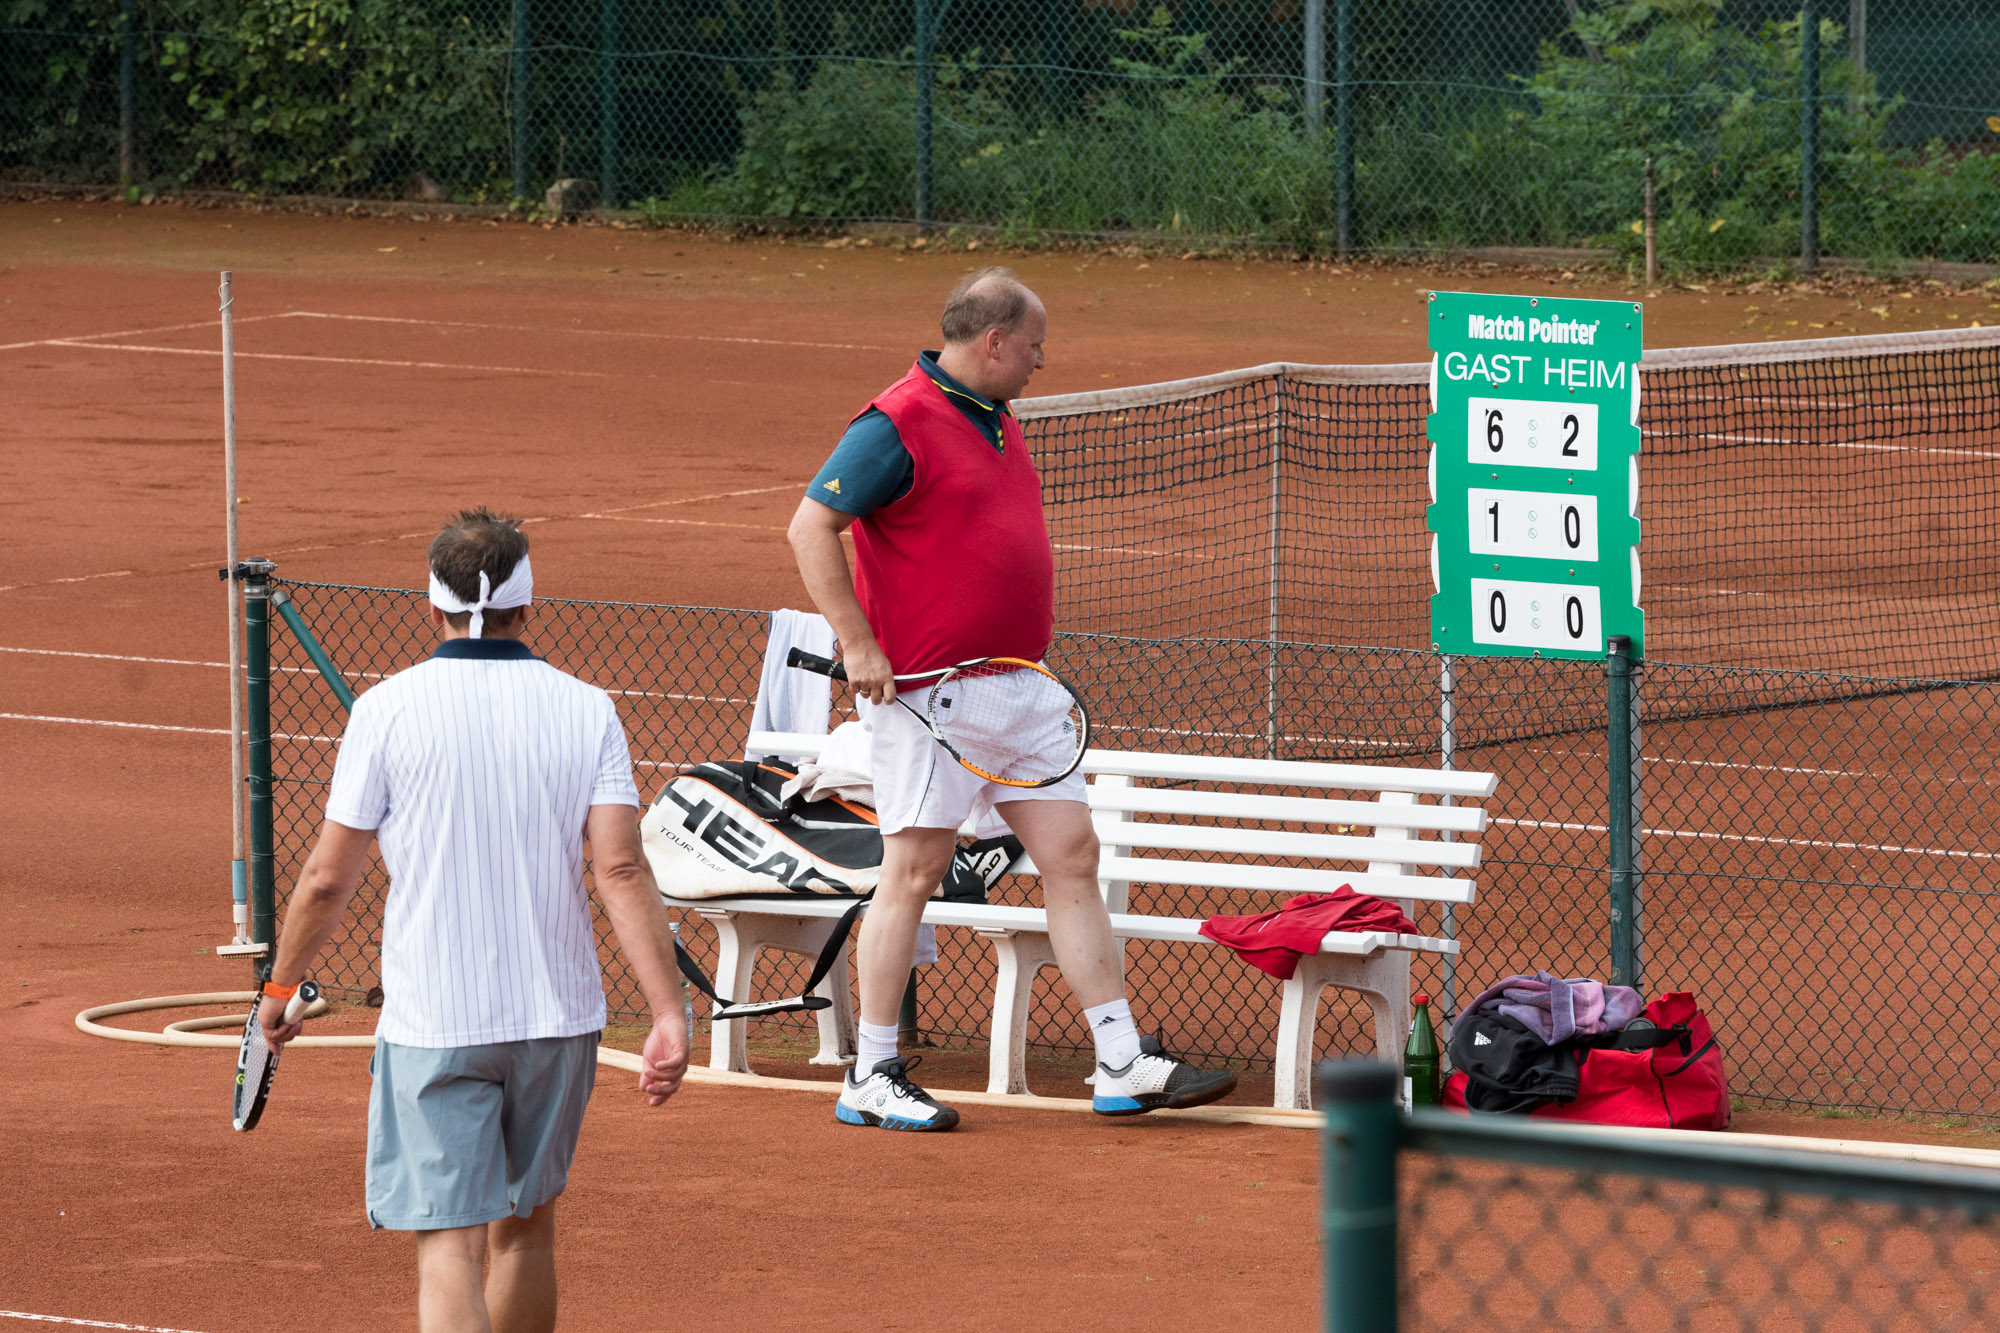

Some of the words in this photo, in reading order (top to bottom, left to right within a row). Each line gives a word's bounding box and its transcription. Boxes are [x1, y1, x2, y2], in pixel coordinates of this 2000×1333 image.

[1468, 314, 1525, 341] Match
[1443, 351, 1532, 383] GAST
[1544, 357, 1625, 389] HEIM
[1487, 409, 1504, 453] 6
[1562, 414, 1579, 457] 2
[1488, 501, 1499, 543] 1
[1564, 505, 1581, 549] 0
[1490, 590, 1506, 633] 0
[1566, 596, 1583, 639] 0
[660, 825, 694, 853] TOUR
